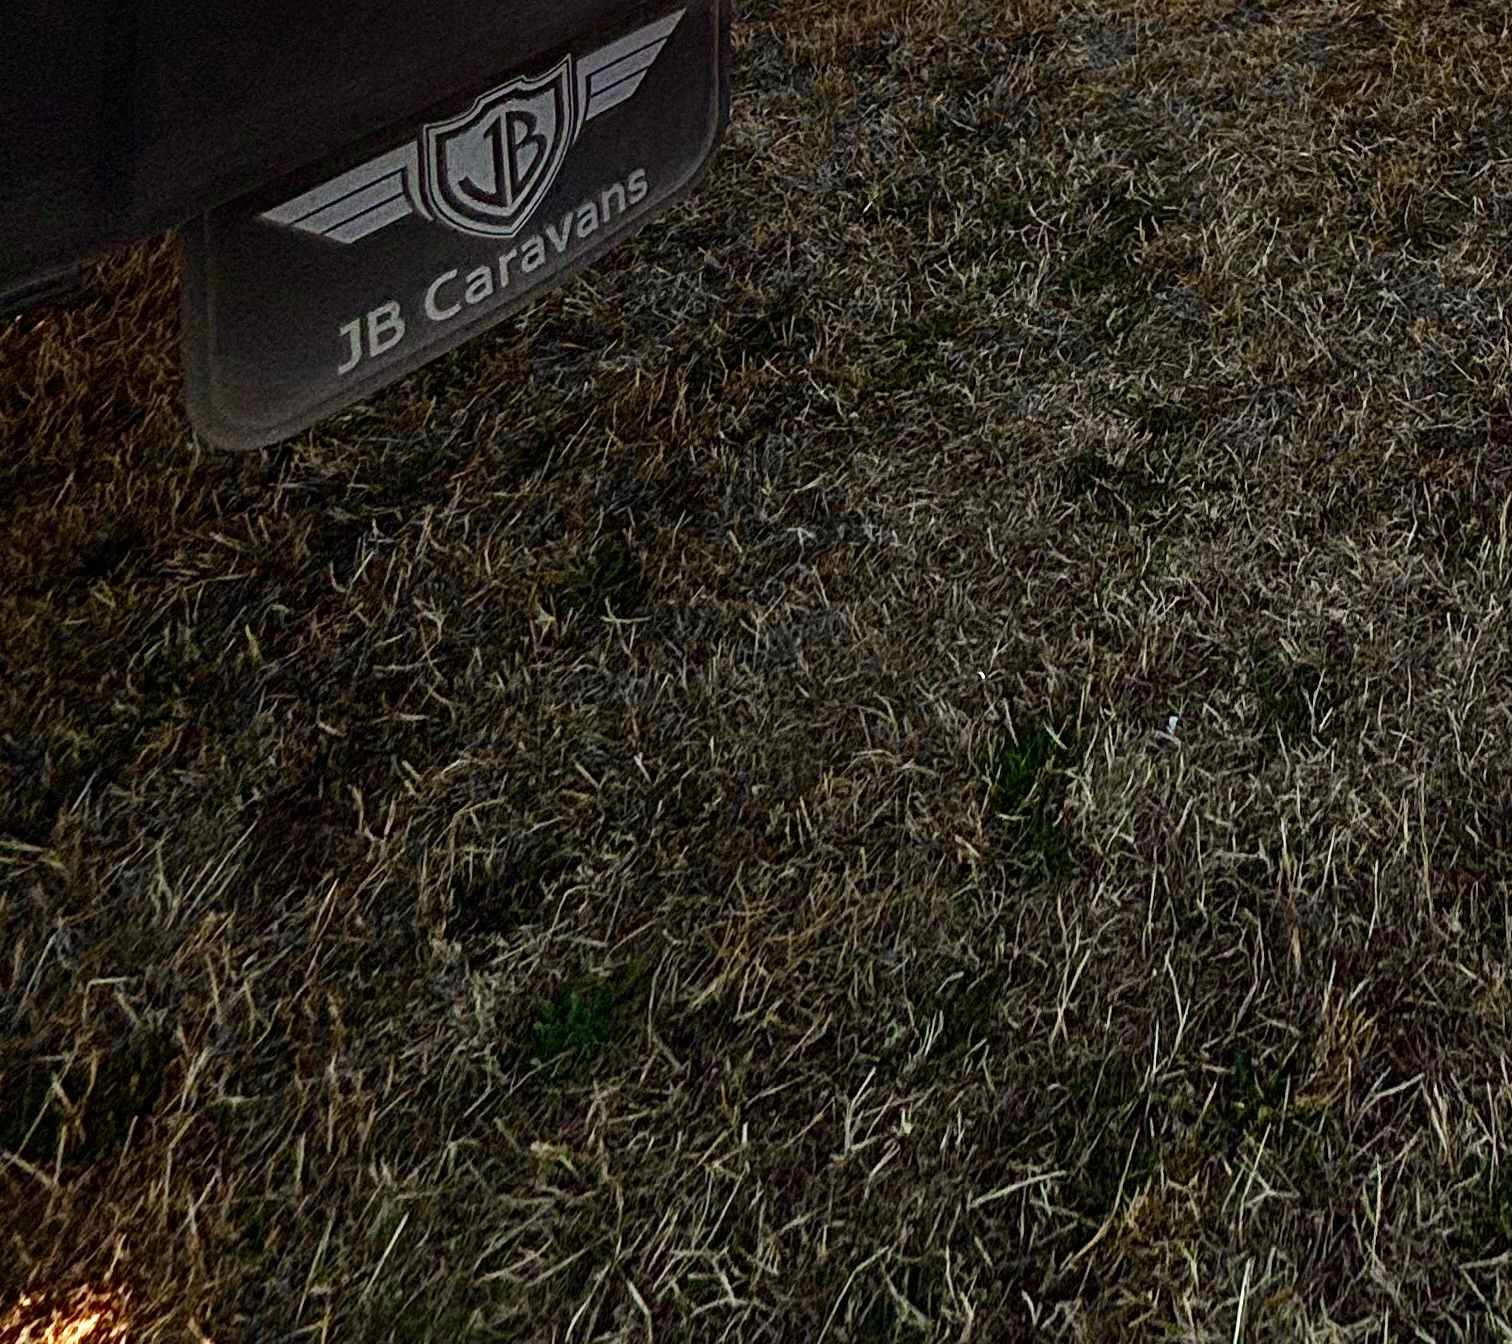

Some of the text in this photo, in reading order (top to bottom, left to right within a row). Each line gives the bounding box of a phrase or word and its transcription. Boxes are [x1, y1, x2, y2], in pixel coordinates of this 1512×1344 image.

[459, 109, 549, 209] JB
[337, 167, 650, 377] JB Caravans
